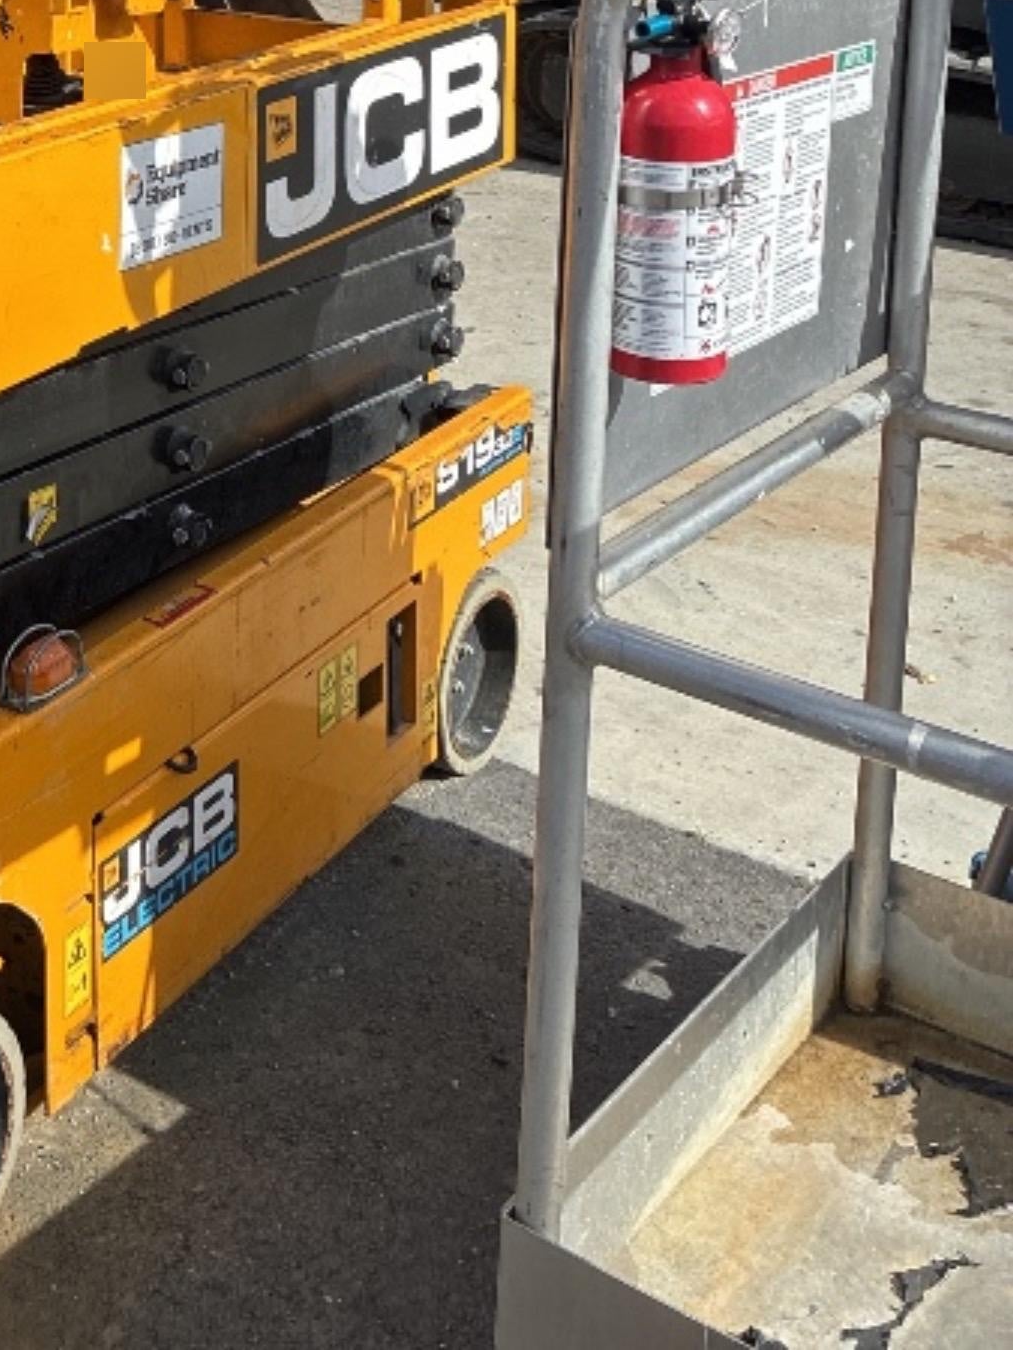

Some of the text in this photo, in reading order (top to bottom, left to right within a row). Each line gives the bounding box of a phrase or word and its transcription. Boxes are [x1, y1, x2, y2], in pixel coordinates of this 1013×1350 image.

[265, 32, 501, 239] JCB
[102, 772, 235, 926] JCB
[102, 828, 237, 960] ELECTRIC
